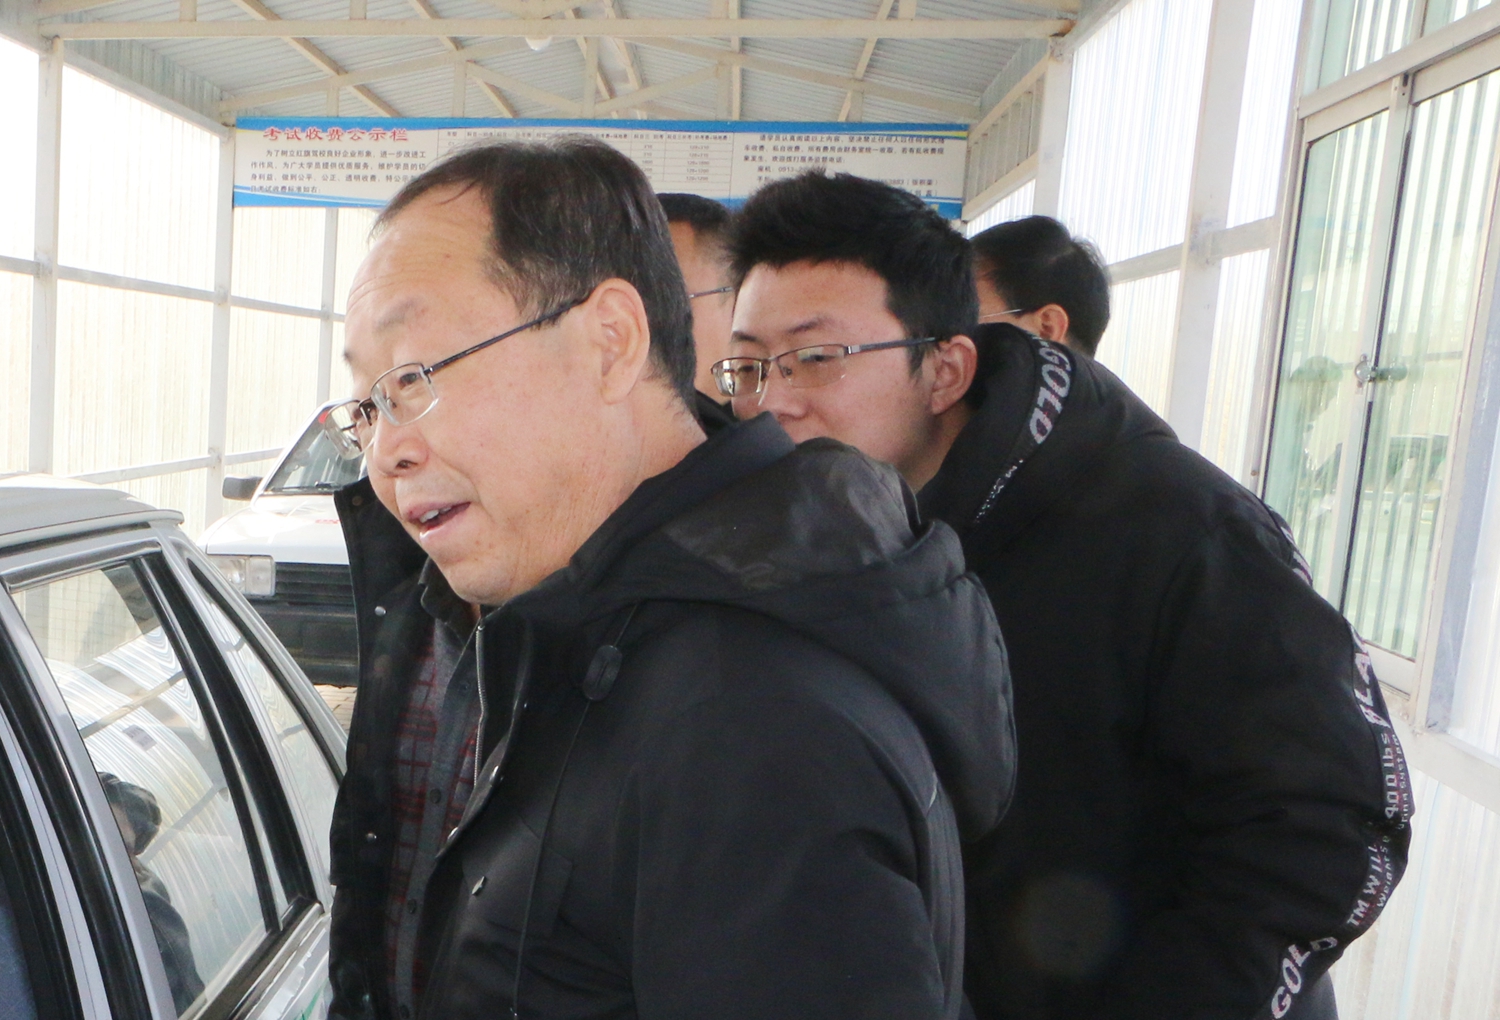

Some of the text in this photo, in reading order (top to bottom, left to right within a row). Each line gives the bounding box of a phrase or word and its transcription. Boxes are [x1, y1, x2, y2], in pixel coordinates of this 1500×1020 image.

[263, 126, 409, 142] 考试收费公示栏
